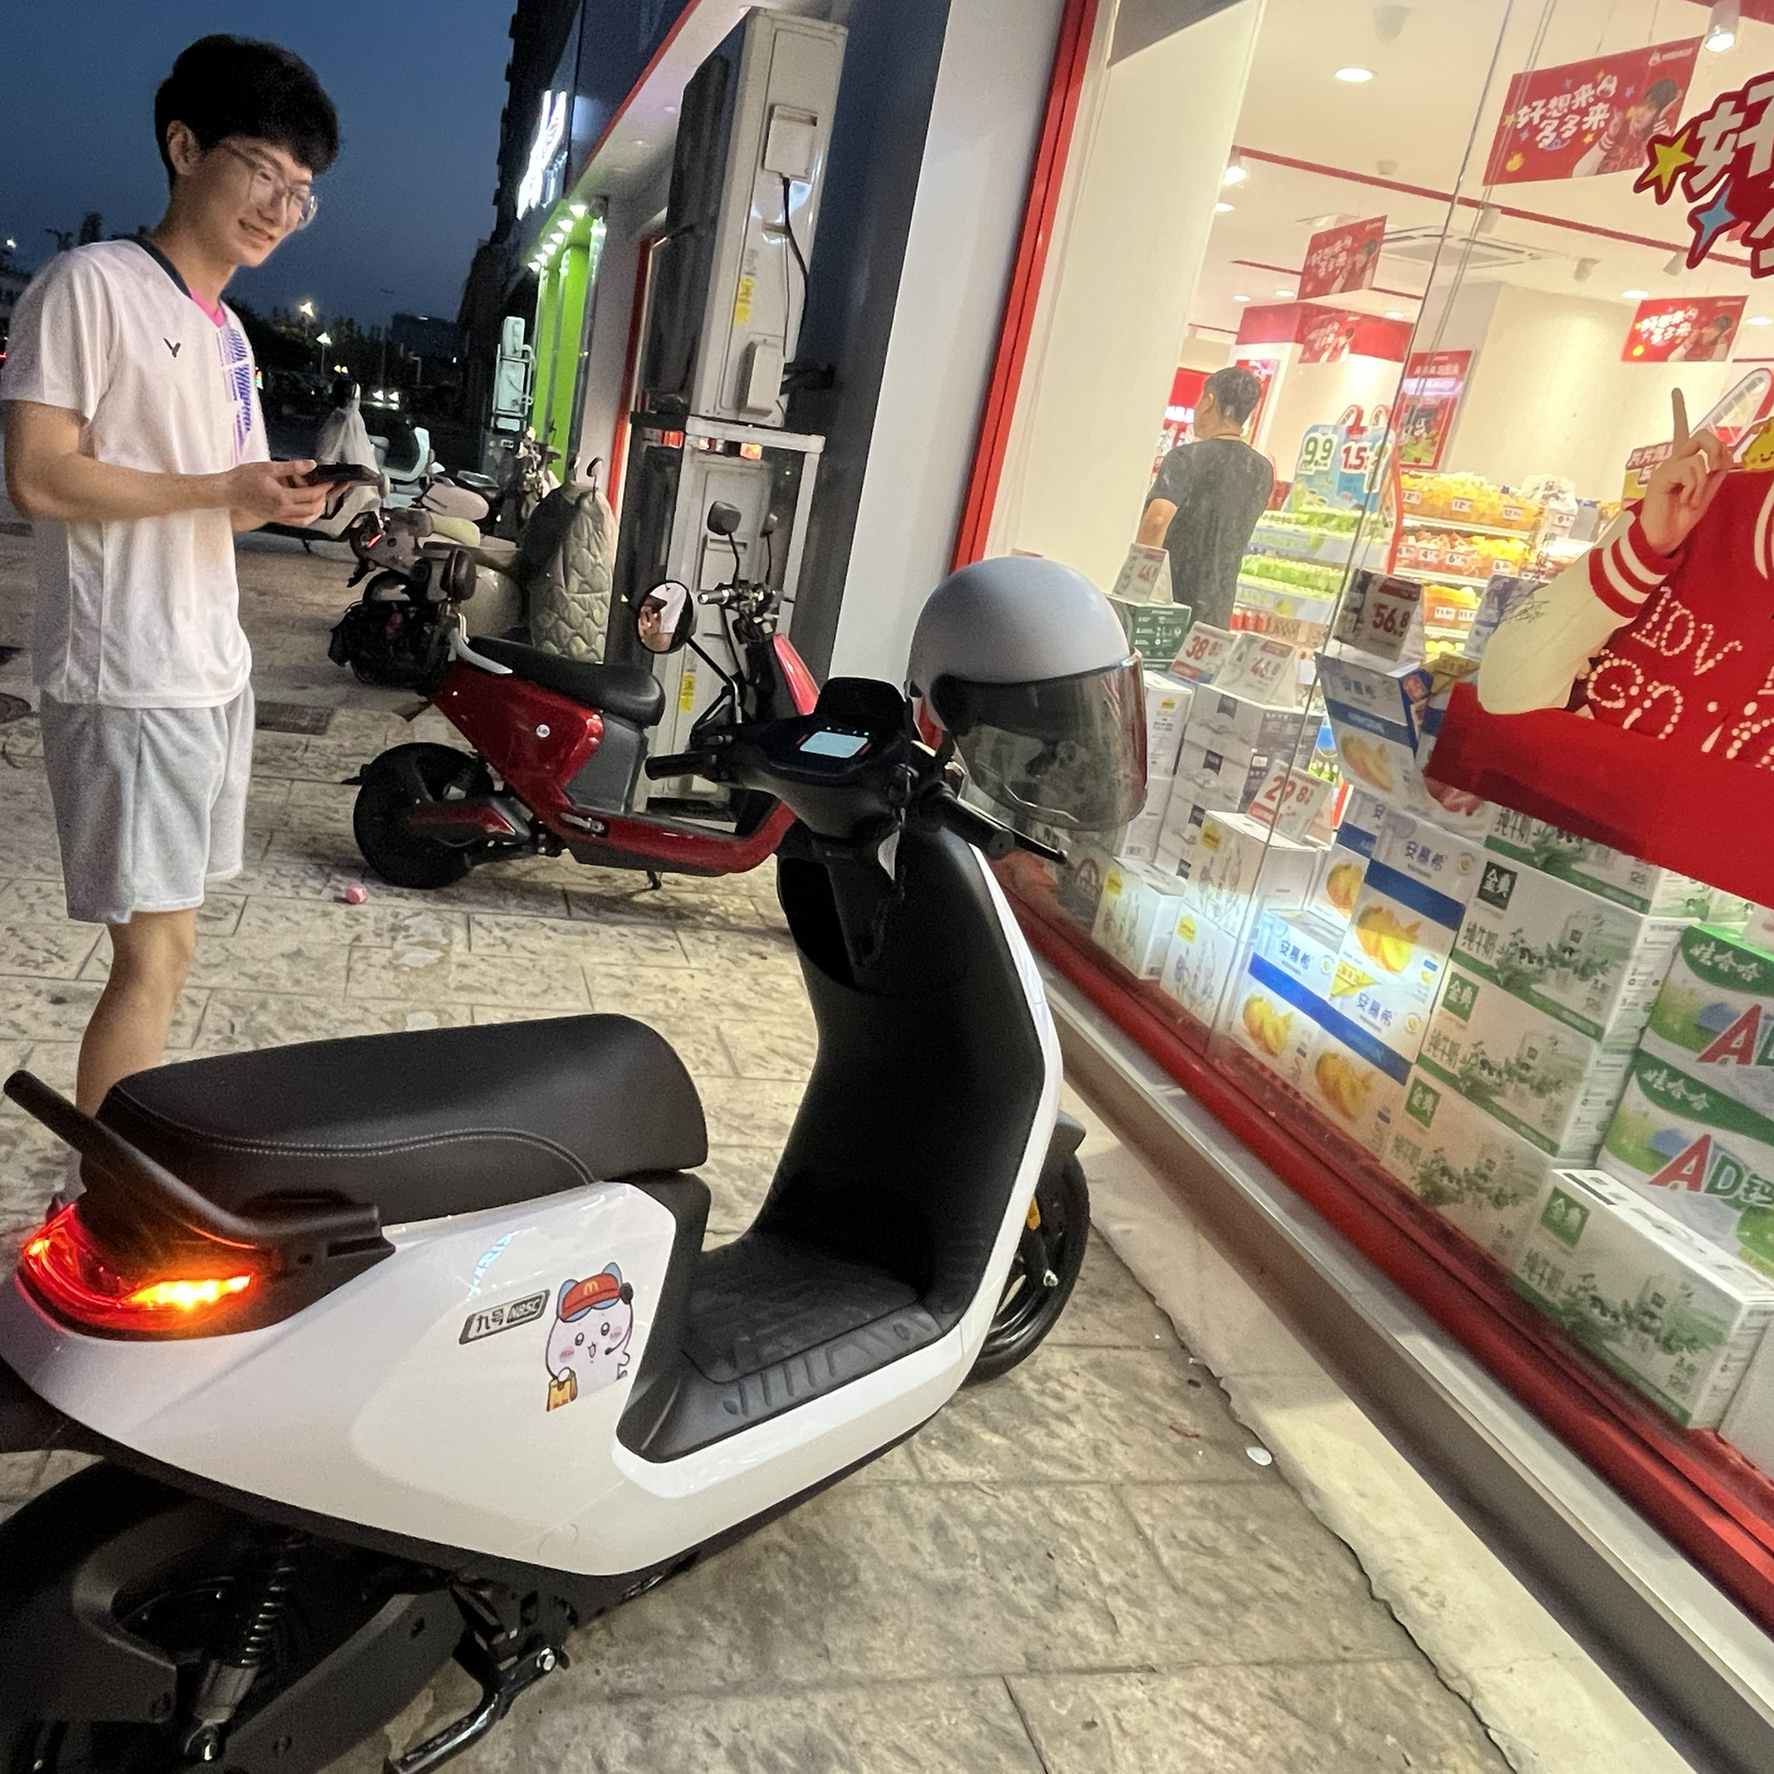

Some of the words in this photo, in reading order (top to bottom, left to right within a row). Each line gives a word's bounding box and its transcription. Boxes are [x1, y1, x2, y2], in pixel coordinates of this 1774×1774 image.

[1516, 83, 1596, 129] 好想来
[1535, 102, 1611, 149] 多多来
[1304, 436, 1334, 467] 9.9
[1371, 603, 1411, 634] 56.8
[1404, 840, 1444, 872] 安慕希
[1279, 939, 1312, 970] 安慕希
[1689, 940, 1761, 982] 娃哈哈
[1356, 992, 1394, 1028] 安慕希
[1641, 1069, 1711, 1111] 娃哈哈
[475, 1307, 504, 1334] 九号
